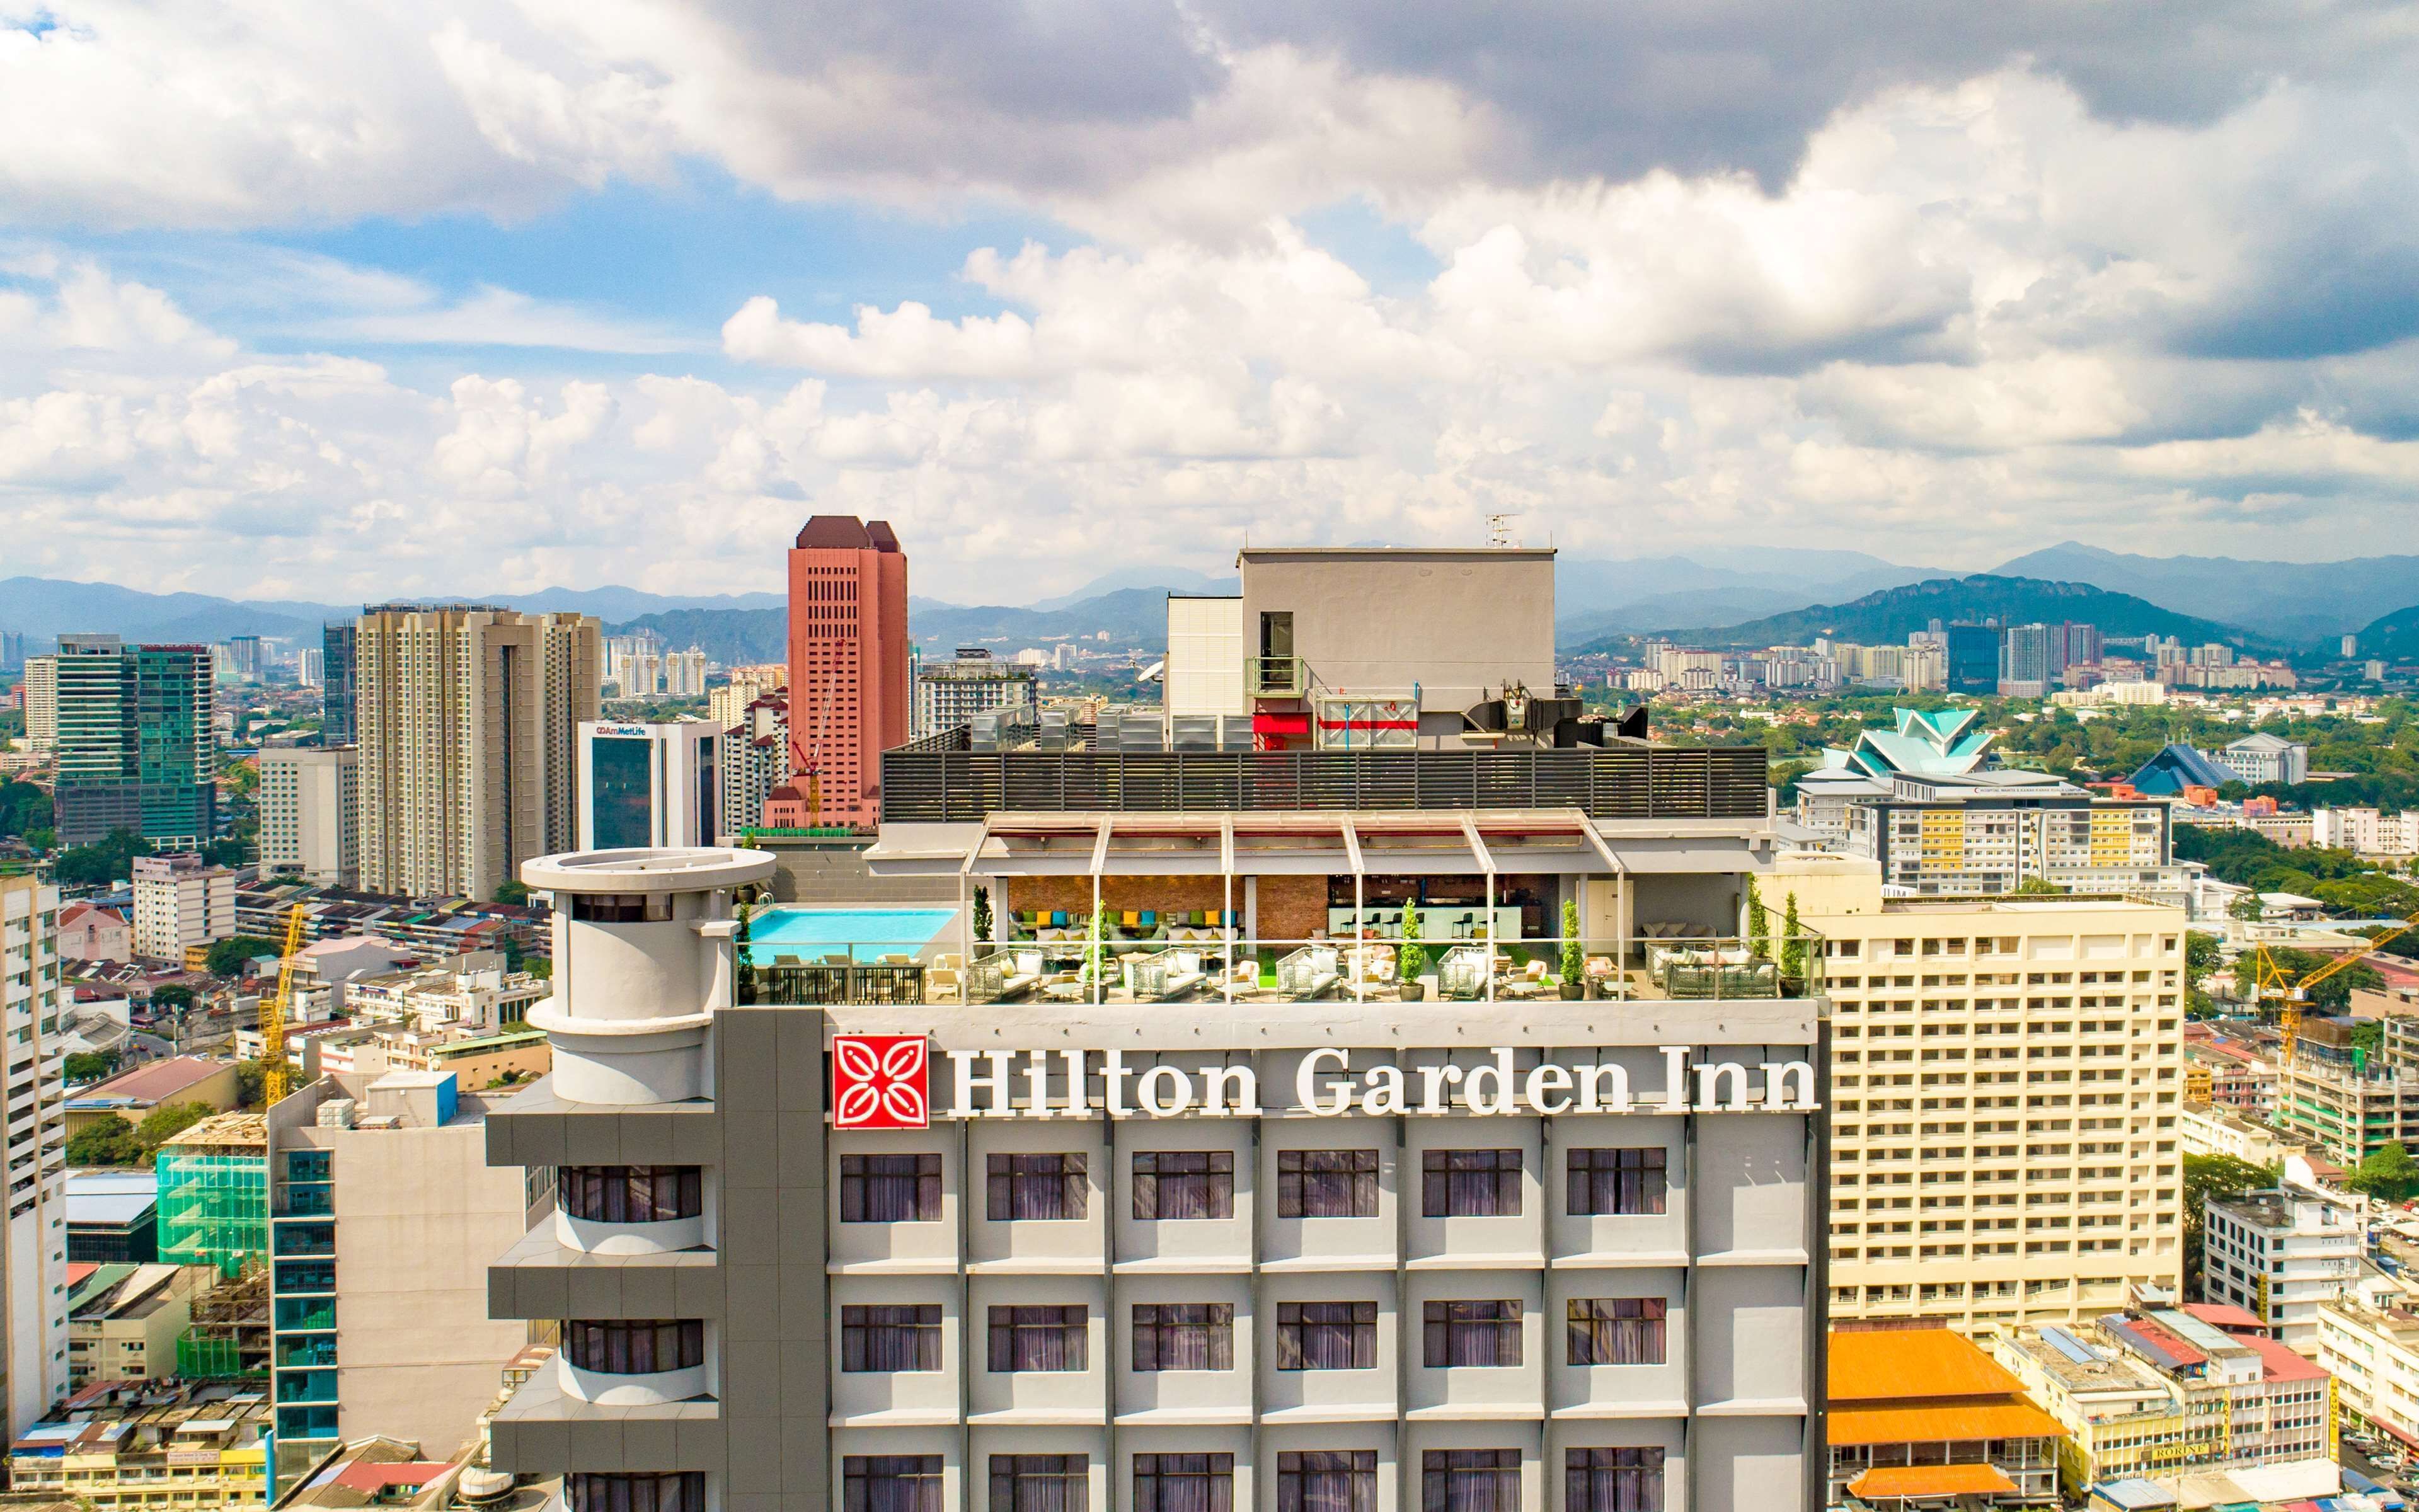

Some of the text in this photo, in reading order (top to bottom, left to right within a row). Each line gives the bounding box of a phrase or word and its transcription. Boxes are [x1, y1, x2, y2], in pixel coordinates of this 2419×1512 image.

[606, 726, 646, 735] AmMetLife
[947, 1046, 1822, 1117] Hilton Garden Inn
